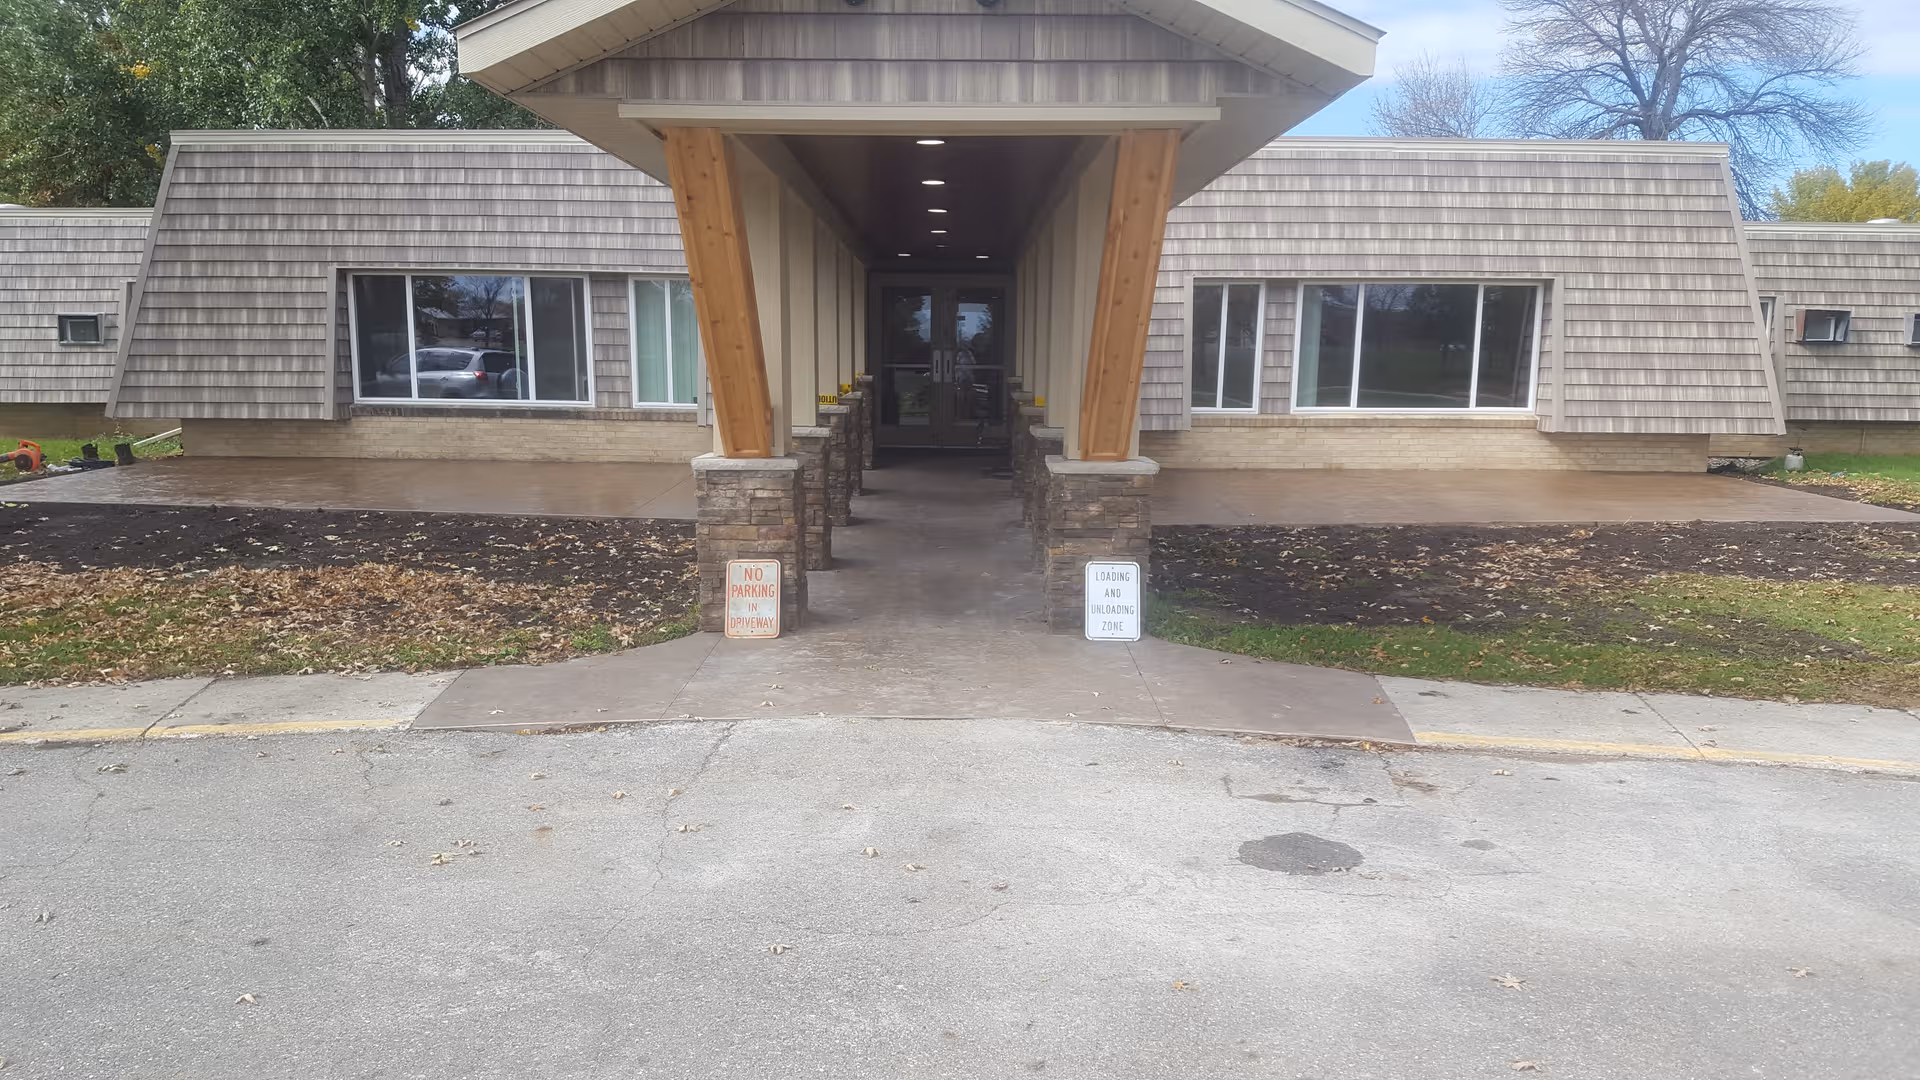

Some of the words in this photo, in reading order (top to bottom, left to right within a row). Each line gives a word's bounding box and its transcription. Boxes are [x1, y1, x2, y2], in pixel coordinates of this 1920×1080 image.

[744, 567, 763, 581] NO
[1095, 571, 1130, 582] LOADING
[731, 584, 775, 598] PARKING
[1104, 588, 1121, 598] AND
[748, 603, 758, 612] IN
[1091, 604, 1135, 615] UNLOADING
[730, 617, 775, 629] DRIVEWAY
[1102, 621, 1124, 631] ZONE
